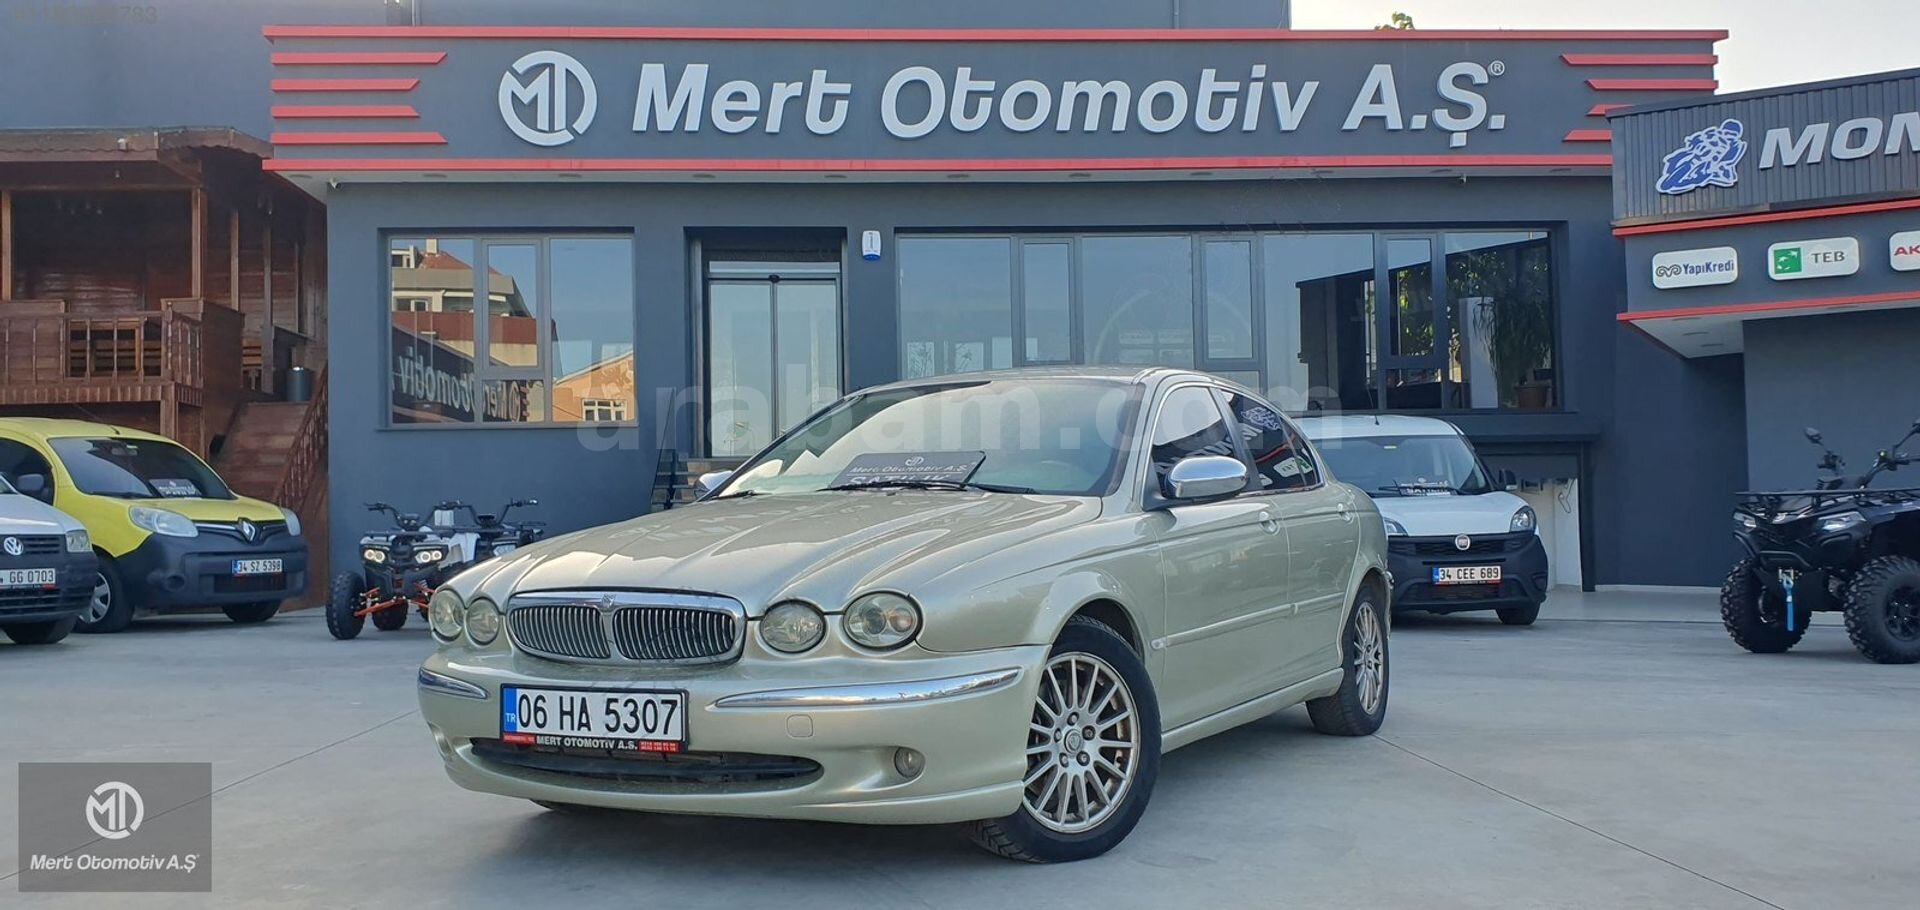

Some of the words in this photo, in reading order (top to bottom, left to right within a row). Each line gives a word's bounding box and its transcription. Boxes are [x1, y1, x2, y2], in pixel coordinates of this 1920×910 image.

[632, 63, 851, 135] Mert
[881, 64, 1320, 139] Otomotiv
[1811, 251, 1845, 264] TEB
[238, 561, 247, 572] 34
[27, 570, 54, 583] 0703
[1440, 568, 1452, 580] 34
[1456, 568, 1475, 580] CEE
[1480, 567, 1498, 578] 689
[506, 712, 516, 722] TR
[518, 694, 547, 729] 06
[559, 695, 592, 732] HA
[604, 698, 678, 735] 5307
[536, 735, 561, 746] MERT
